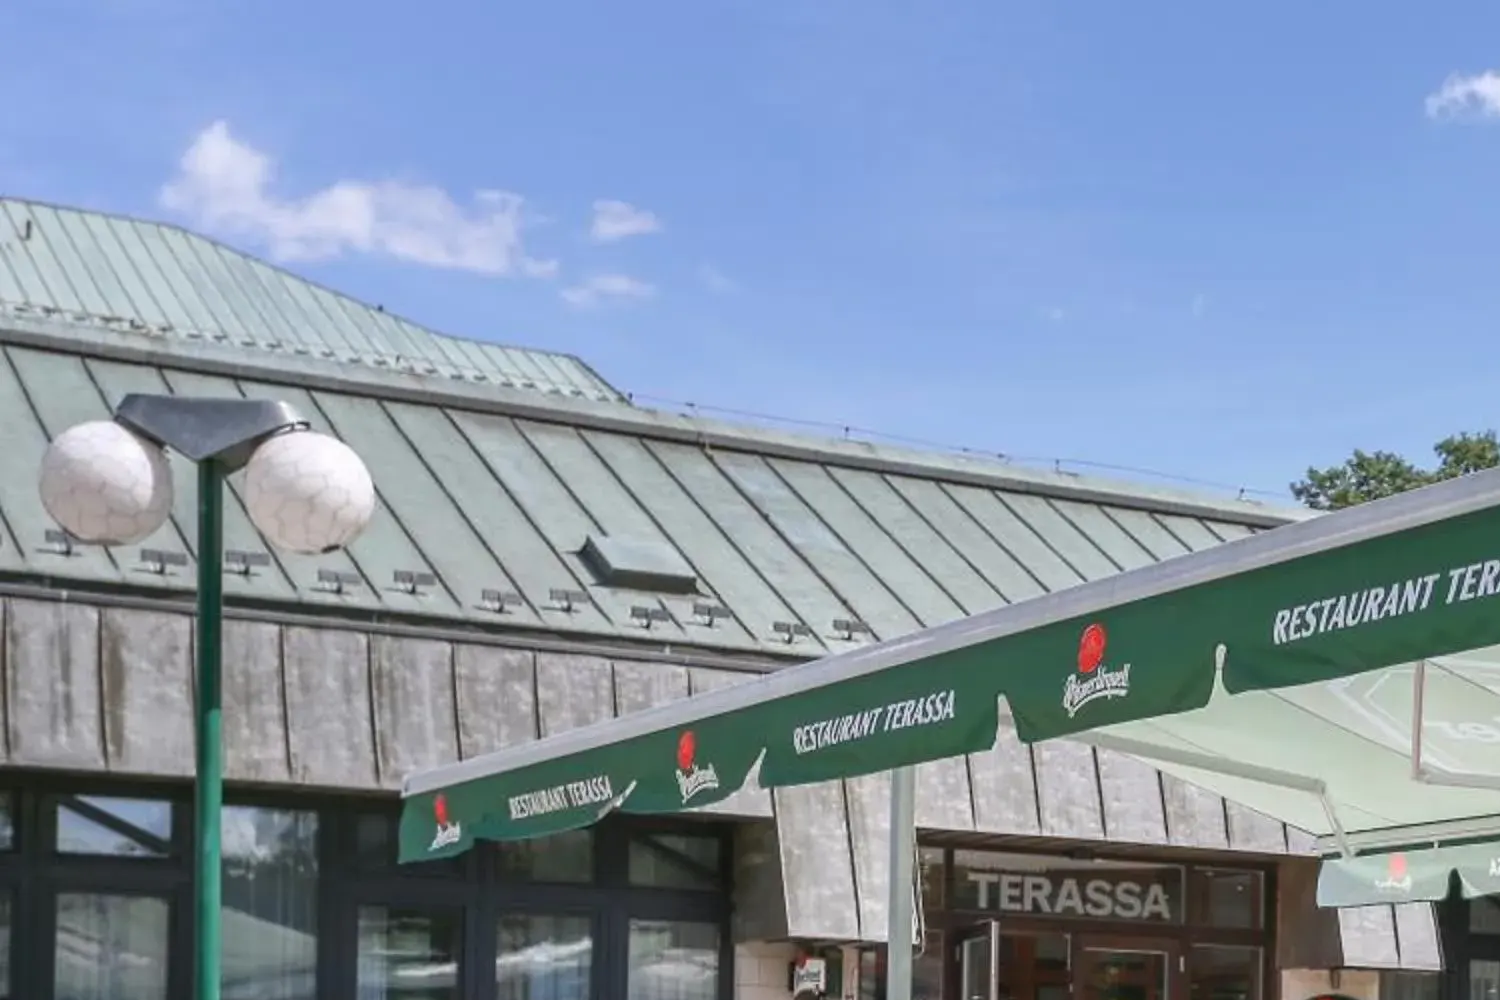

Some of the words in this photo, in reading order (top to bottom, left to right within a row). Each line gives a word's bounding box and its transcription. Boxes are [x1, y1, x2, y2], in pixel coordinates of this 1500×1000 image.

[1272, 574, 1440, 645] RESTAURANT
[793, 707, 883, 754] RESTAURANT
[883, 690, 955, 732] TERASSA
[508, 787, 568, 820] RESTAURANT
[567, 776, 613, 806] TERASSA
[968, 872, 1171, 920] TERASSA
